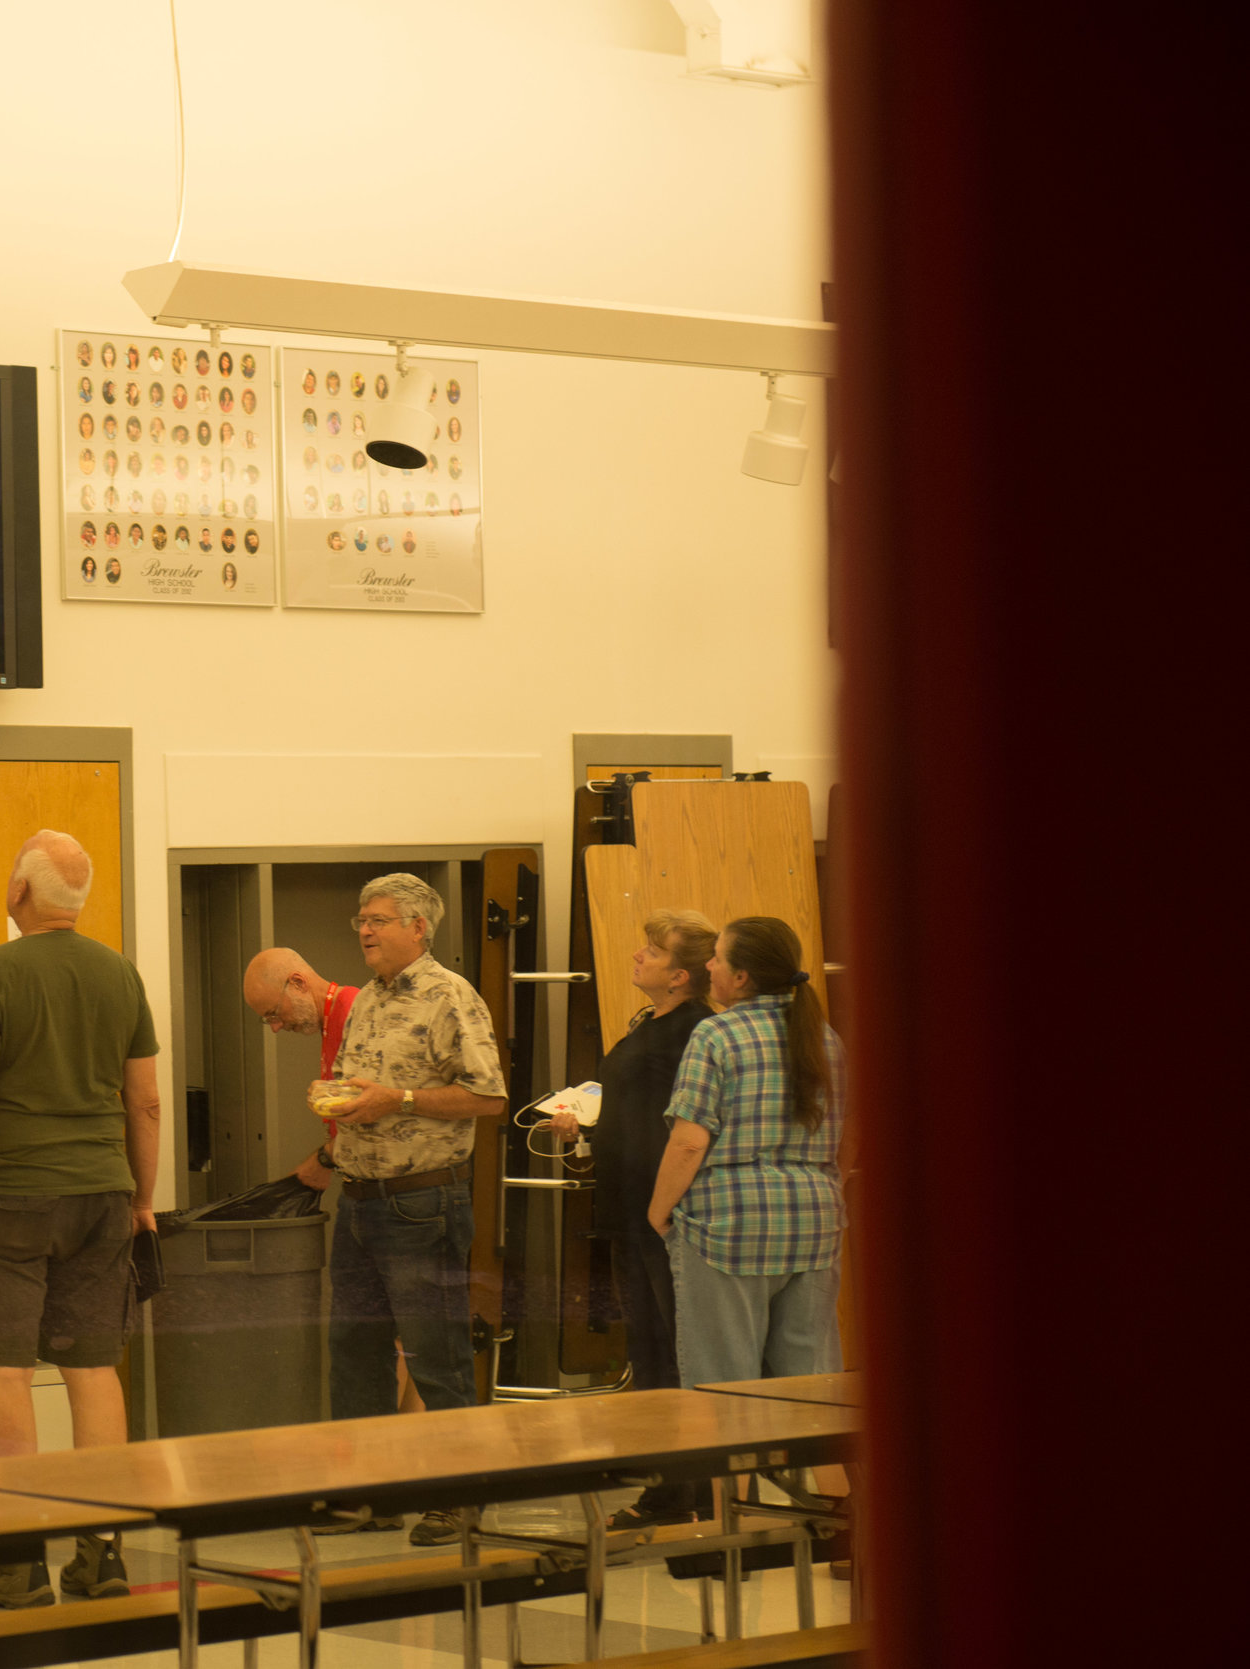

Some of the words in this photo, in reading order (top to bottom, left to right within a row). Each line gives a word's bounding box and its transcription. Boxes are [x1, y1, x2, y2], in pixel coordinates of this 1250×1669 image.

[140, 558, 202, 578] Brewster
[357, 568, 416, 587] Brewster
[168, 579, 196, 588] SCHOOL
